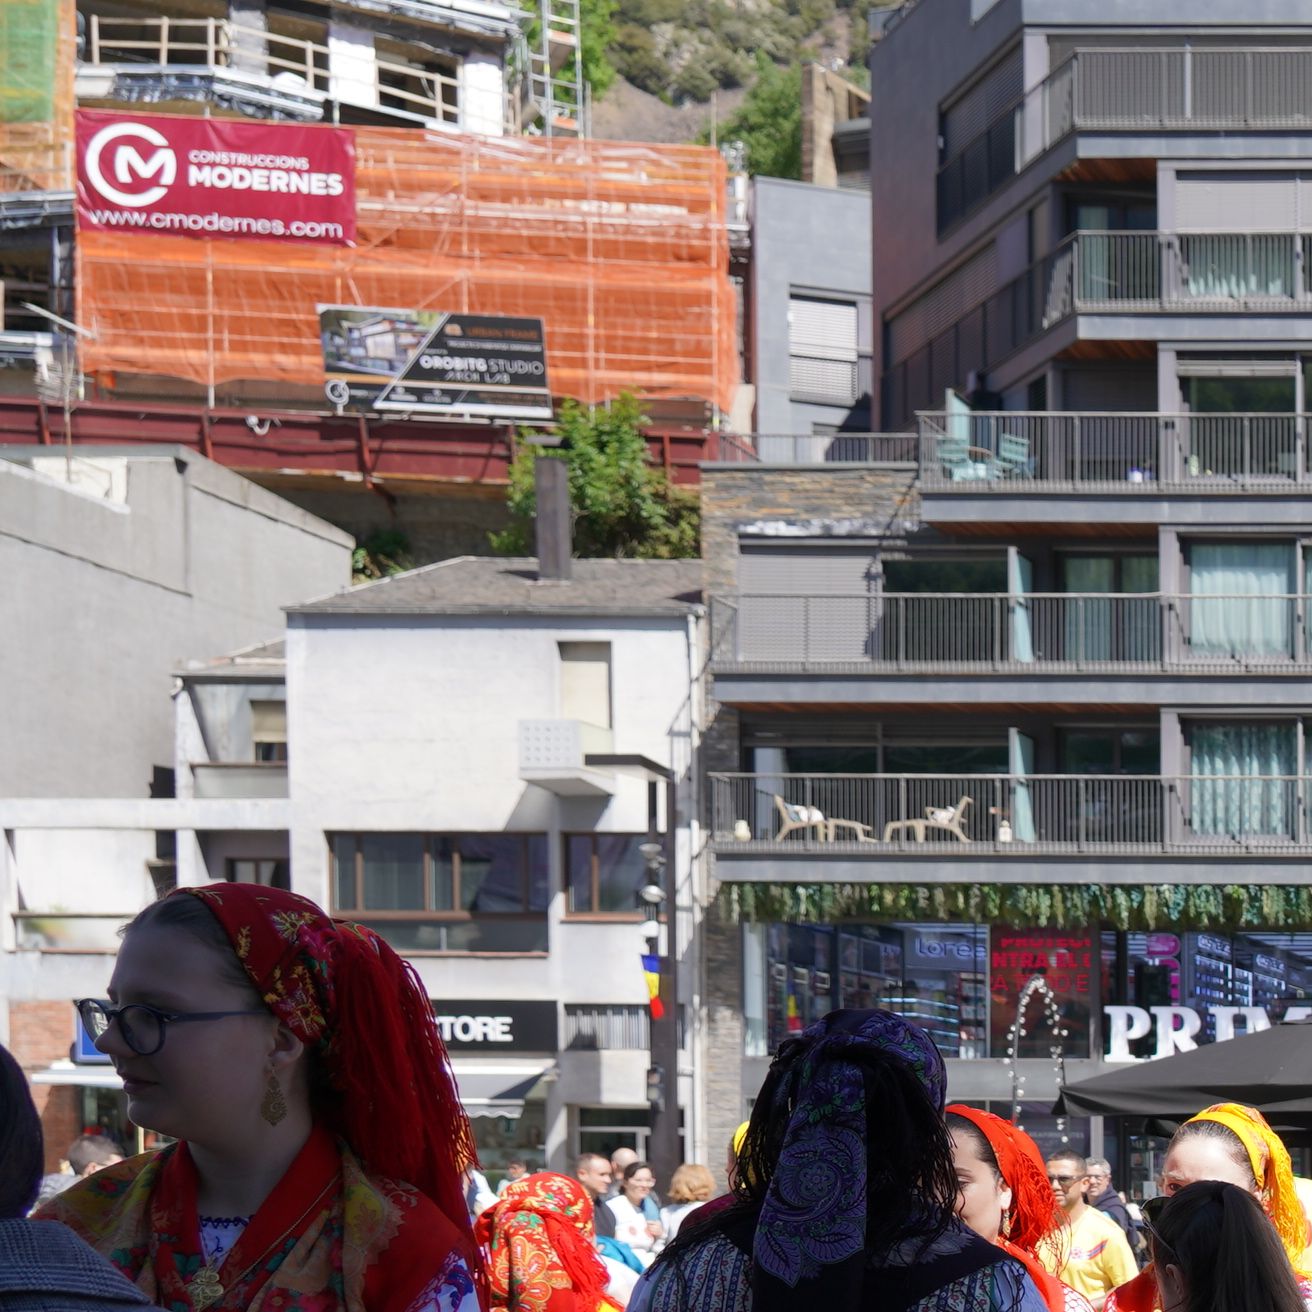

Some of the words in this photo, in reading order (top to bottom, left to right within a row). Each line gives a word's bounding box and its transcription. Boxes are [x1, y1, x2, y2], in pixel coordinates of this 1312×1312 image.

[188, 149, 310, 171] CONSTRUCCIONS
[188, 165, 344, 196] MODERNES
[90, 209, 344, 239] www.cmodernes.com
[488, 359, 545, 376] STUDIO
[435, 1015, 513, 1041] TORE
